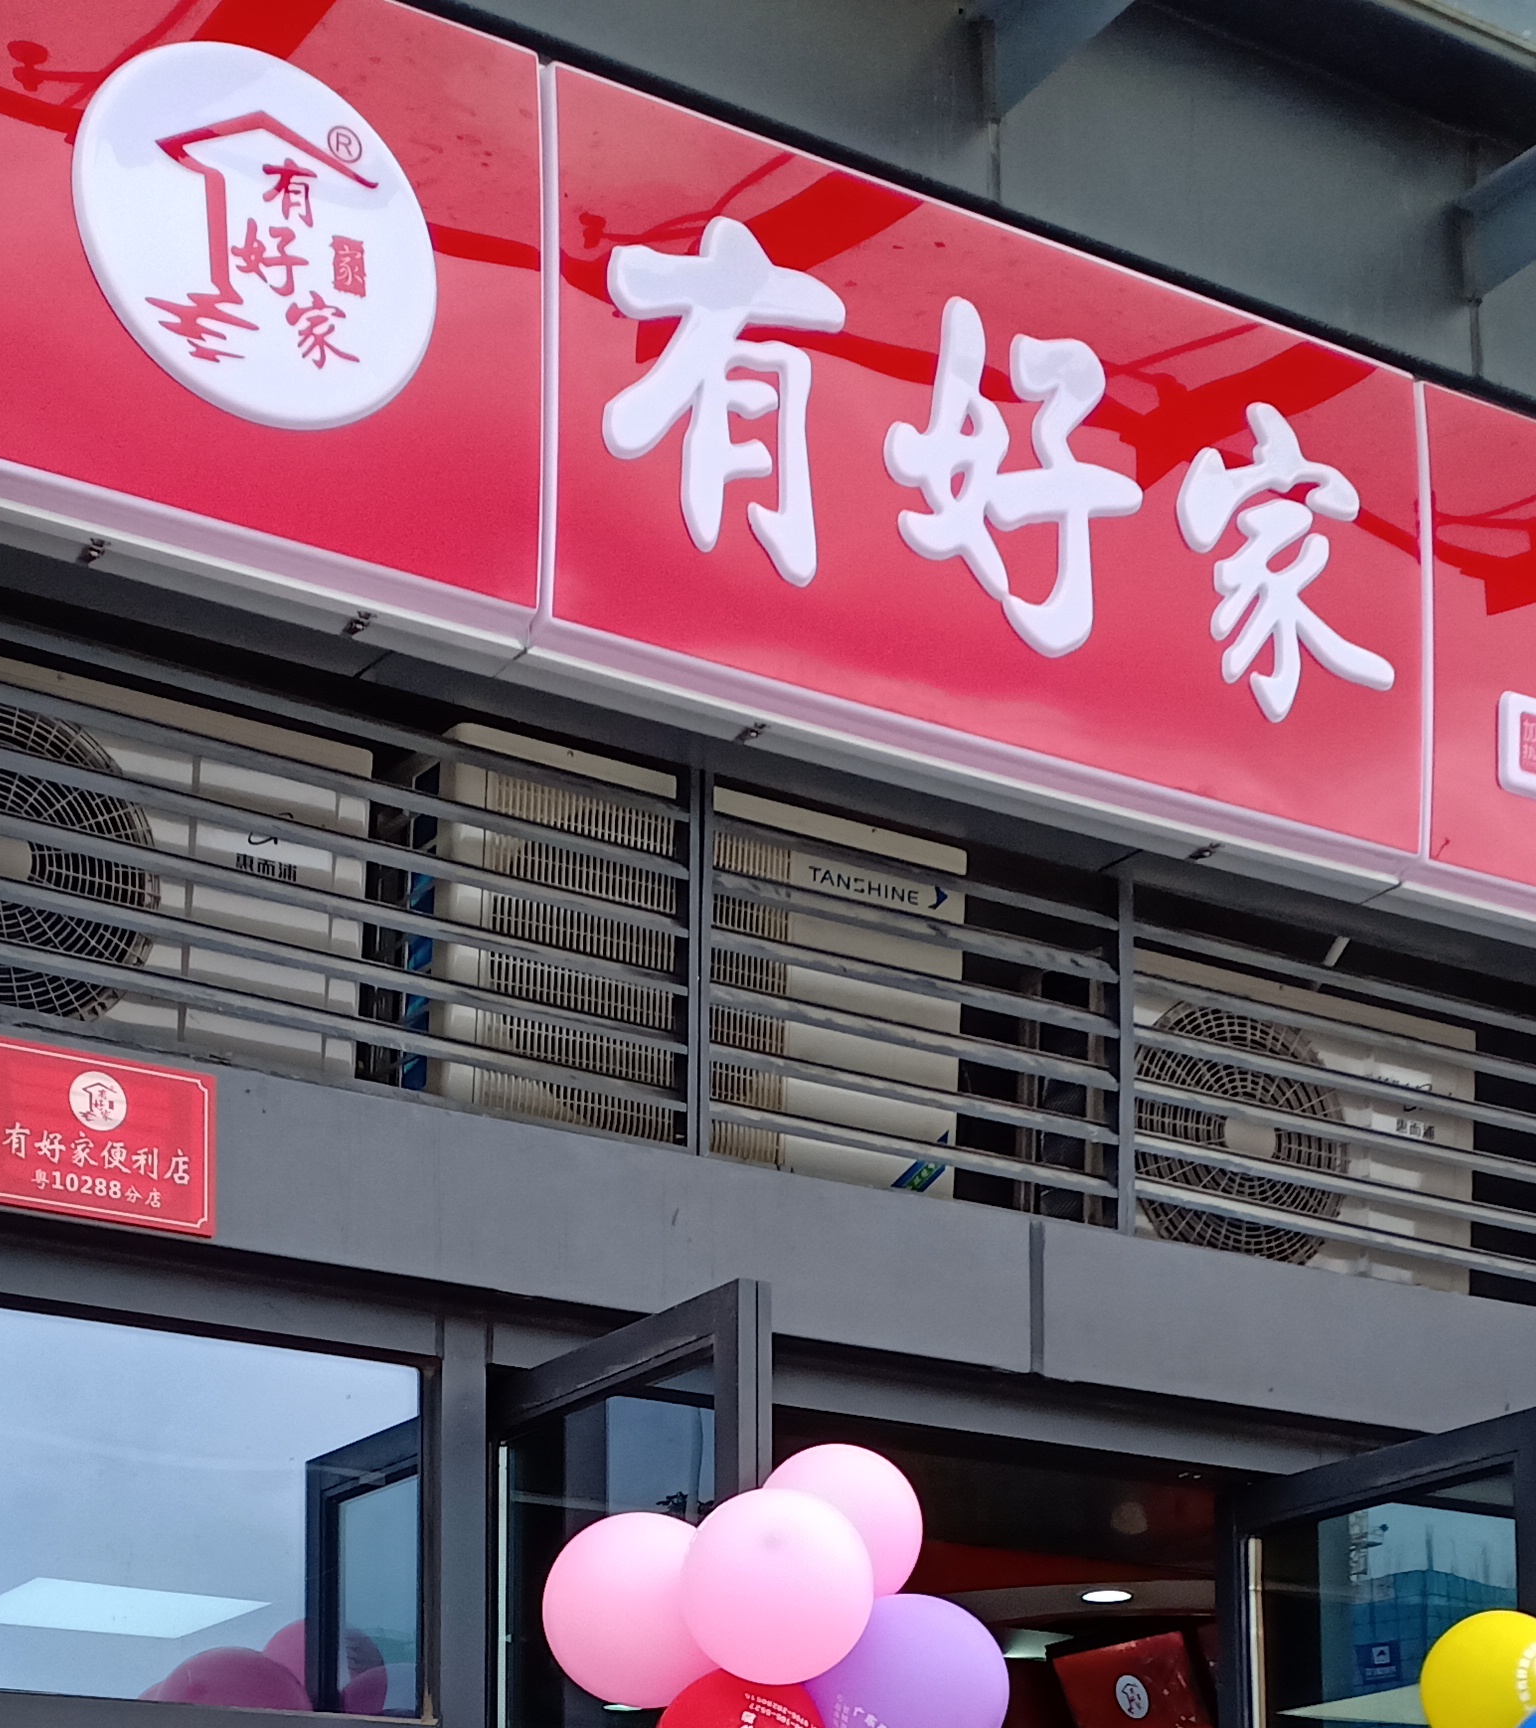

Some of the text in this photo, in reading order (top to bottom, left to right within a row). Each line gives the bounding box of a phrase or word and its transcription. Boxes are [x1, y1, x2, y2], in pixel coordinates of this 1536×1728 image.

[602, 216, 1395, 723] 有好家
[2, 1121, 191, 1185] 有好家便利店
[31, 1168, 162, 1208] 粤10288分店
